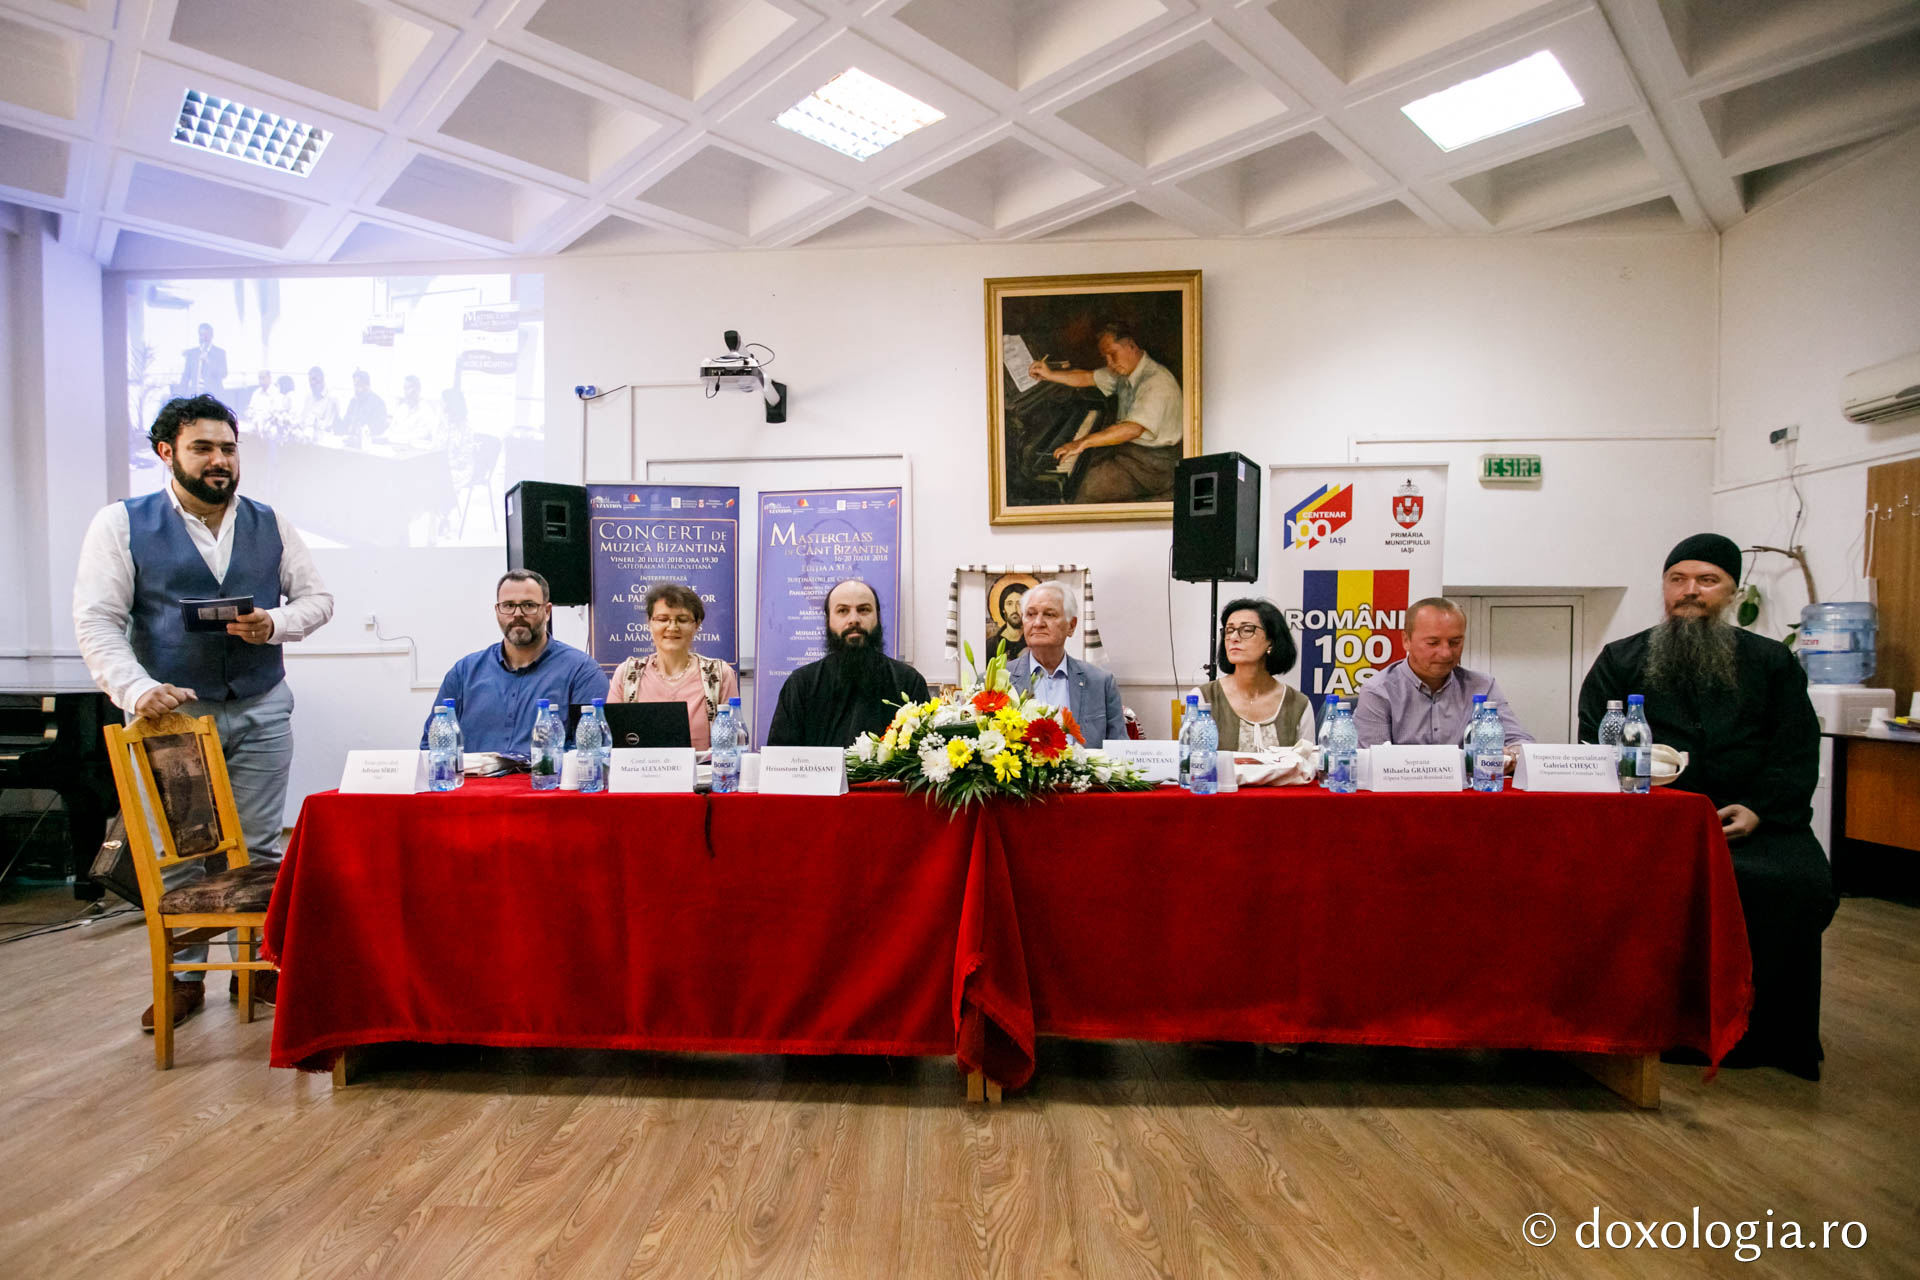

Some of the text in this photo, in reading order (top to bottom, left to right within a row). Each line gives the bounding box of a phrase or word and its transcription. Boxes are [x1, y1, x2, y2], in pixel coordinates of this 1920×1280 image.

[1302, 511, 1347, 519] CENTENAR
[599, 522, 727, 541] CONCERT DE
[770, 521, 873, 546] MASTERCLASS
[600, 541, 727, 553] MUZICĂ BIZANTINĂ
[833, 543, 889, 555] BIZANTIN
[612, 594, 625, 603] AL
[1284, 603, 1405, 631] ROMÂNI
[609, 633, 621, 642] AL
[692, 633, 720, 642] NTIM
[1314, 634, 1393, 665] 100
